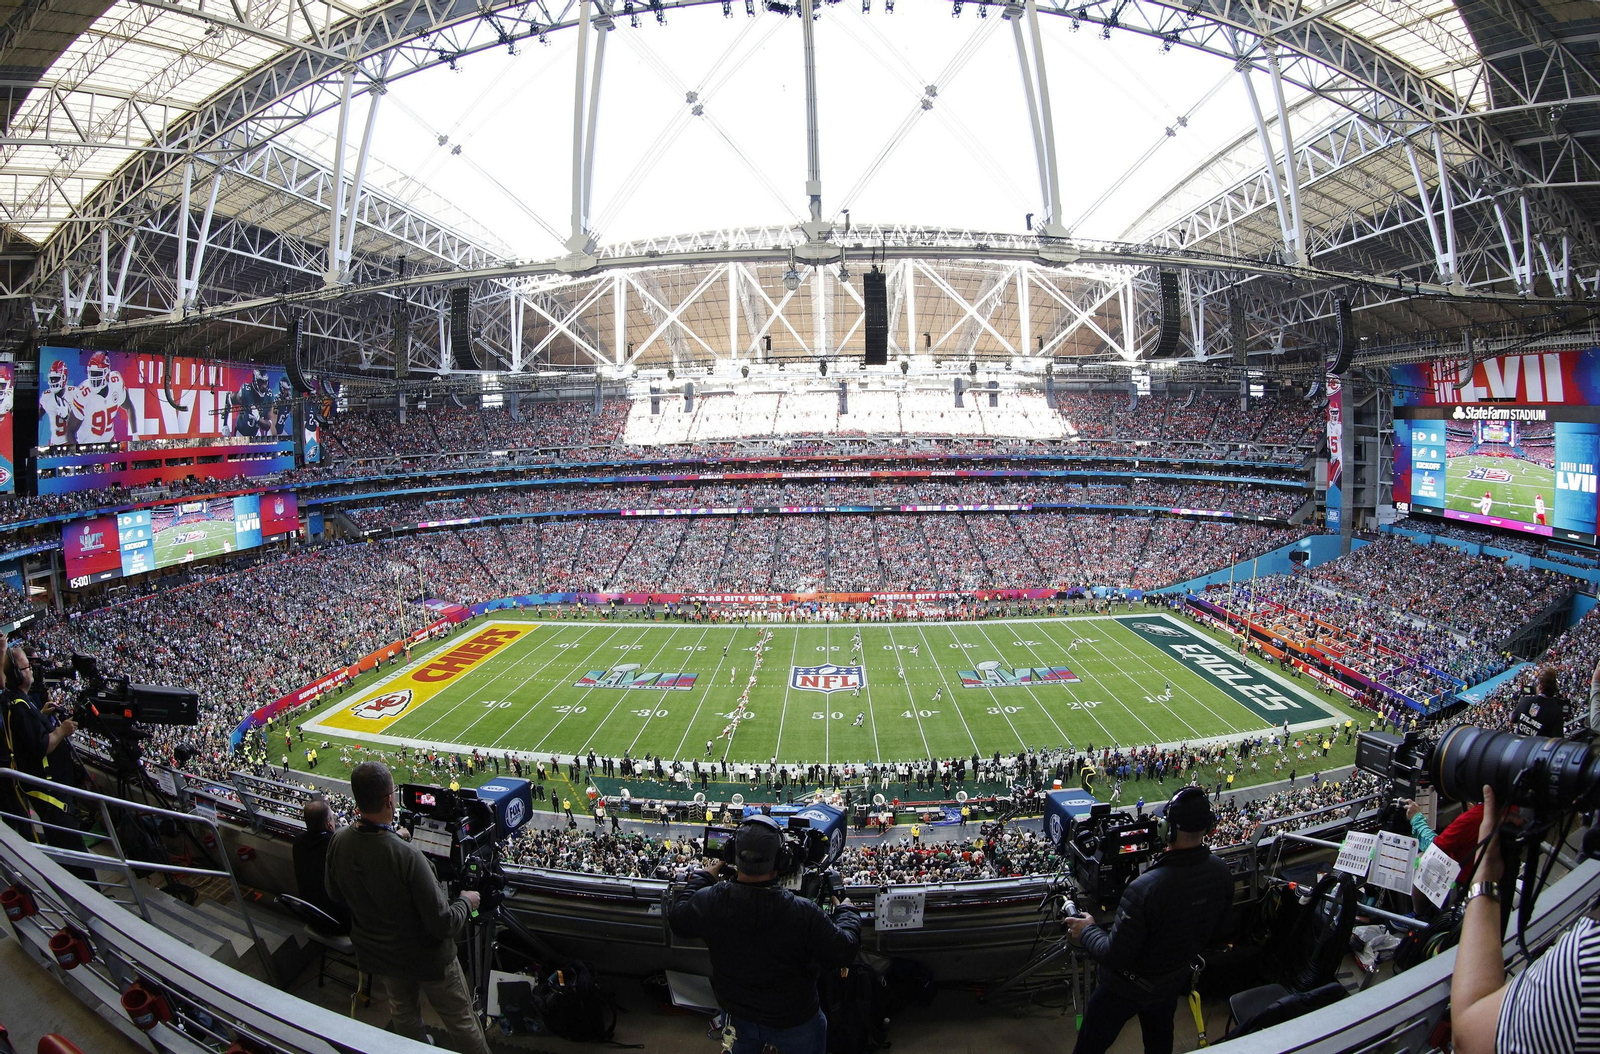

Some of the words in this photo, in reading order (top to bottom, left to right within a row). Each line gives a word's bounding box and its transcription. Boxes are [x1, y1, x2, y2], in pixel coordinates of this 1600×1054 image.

[139, 361, 180, 385] SUPR
[1458, 353, 1564, 403] LVII
[128, 388, 232, 436] LVII
[1511, 409, 1546, 422] STADIUM
[91, 405, 118, 437] 95
[1556, 471, 1597, 493] LVII
[235, 518, 261, 533] LVII
[70, 575, 88, 589] 15:00
[412, 628, 522, 683] CHIEFS
[799, 675, 857, 689] NFL
[1169, 644, 1303, 711] EAGLES
[298, 686, 318, 700] SUPER
[557, 705, 587, 714] 20
[986, 705, 1018, 715] 30
[1067, 700, 1097, 710] 20
[637, 708, 669, 718] 30
[811, 711, 844, 720] 50
[901, 709, 932, 718] 40
[1520, 712, 1543, 730] FILMS
[1519, 723, 1538, 737] CREW
[509, 802, 520, 818] FOX
